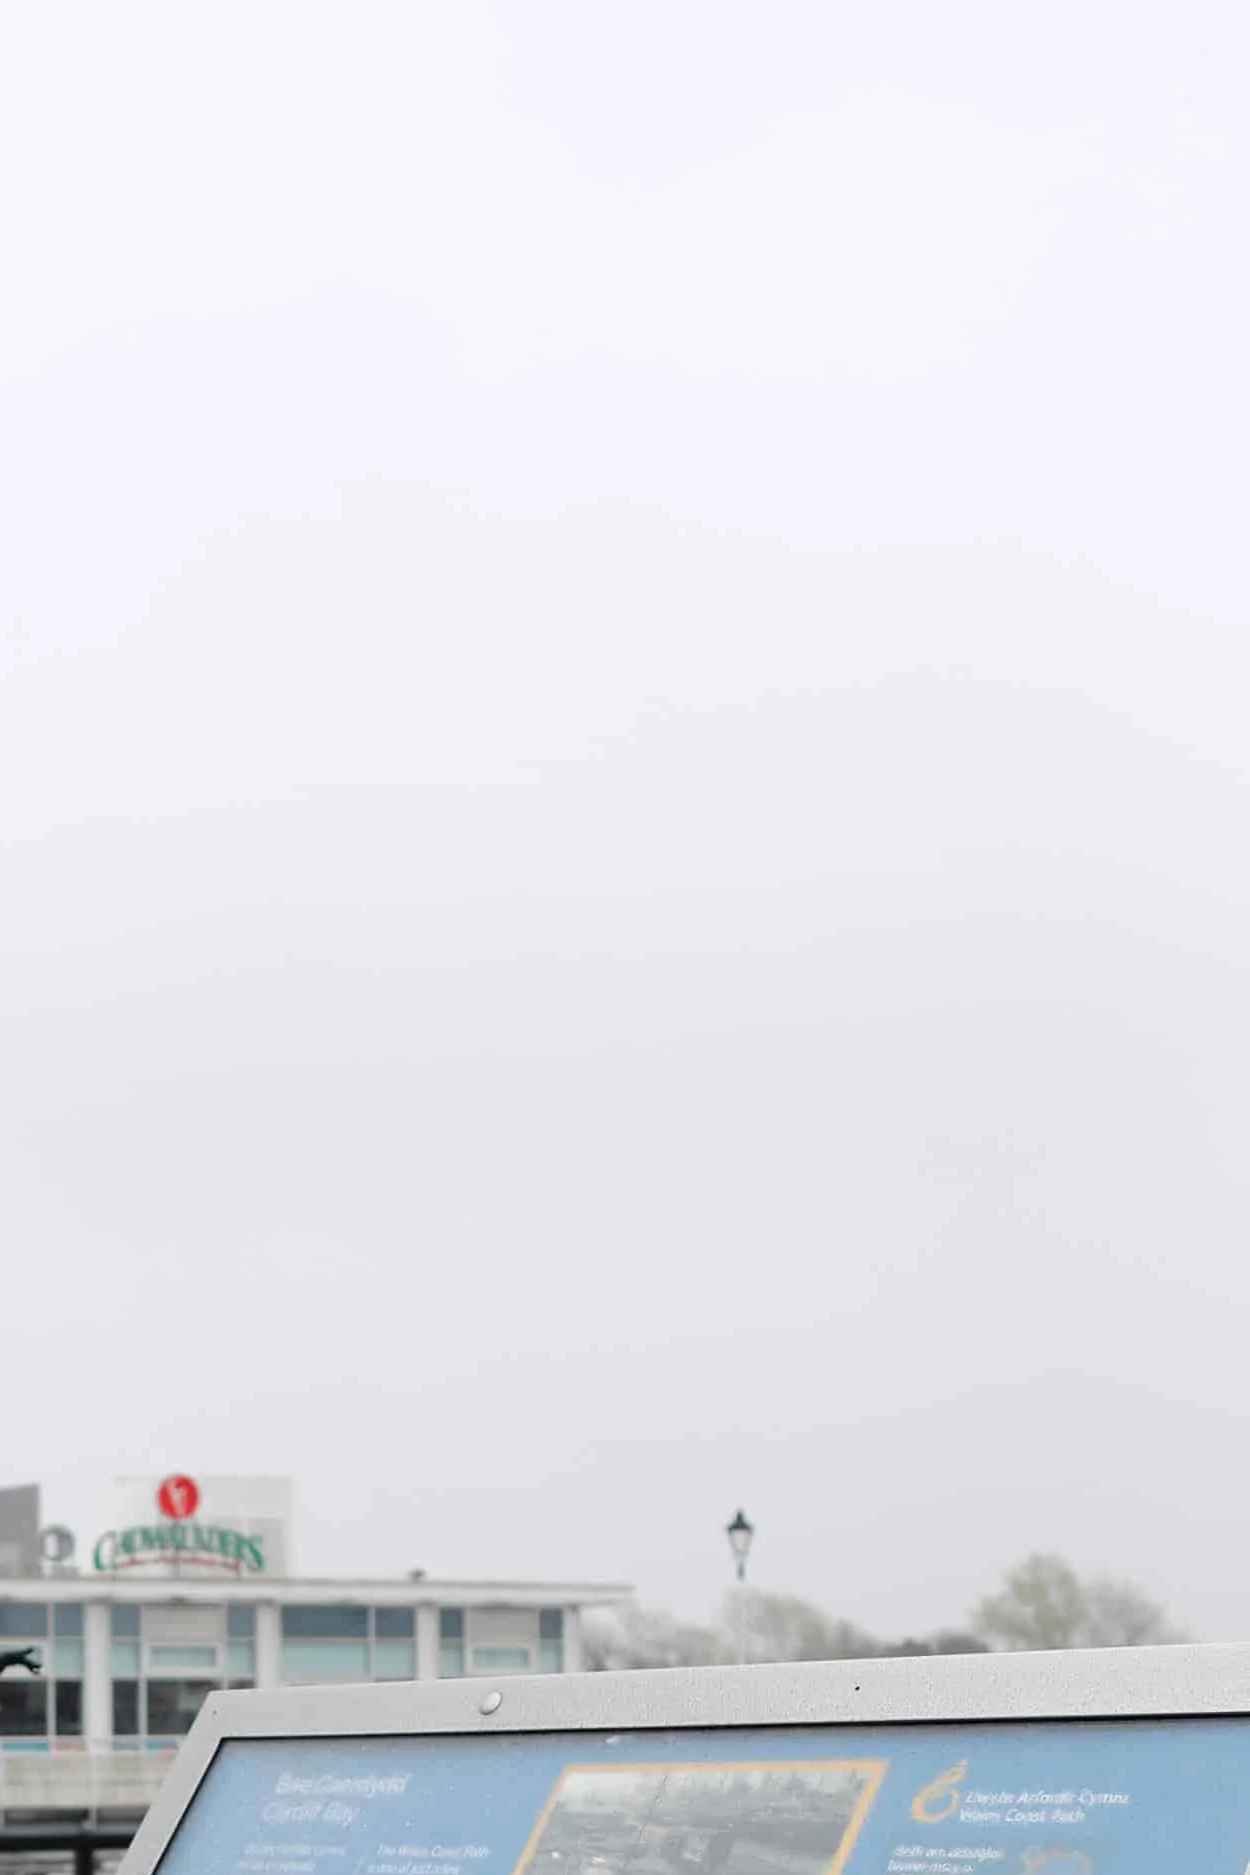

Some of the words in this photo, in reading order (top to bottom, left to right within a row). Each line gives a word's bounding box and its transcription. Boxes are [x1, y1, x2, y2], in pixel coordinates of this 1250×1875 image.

[256, 1801, 327, 1823] Cardiff
[318, 1801, 364, 1824] Bay
[1002, 1809, 1047, 1822] Coast
[1048, 1810, 1088, 1823] Path
[460, 1846, 492, 1859] Path
